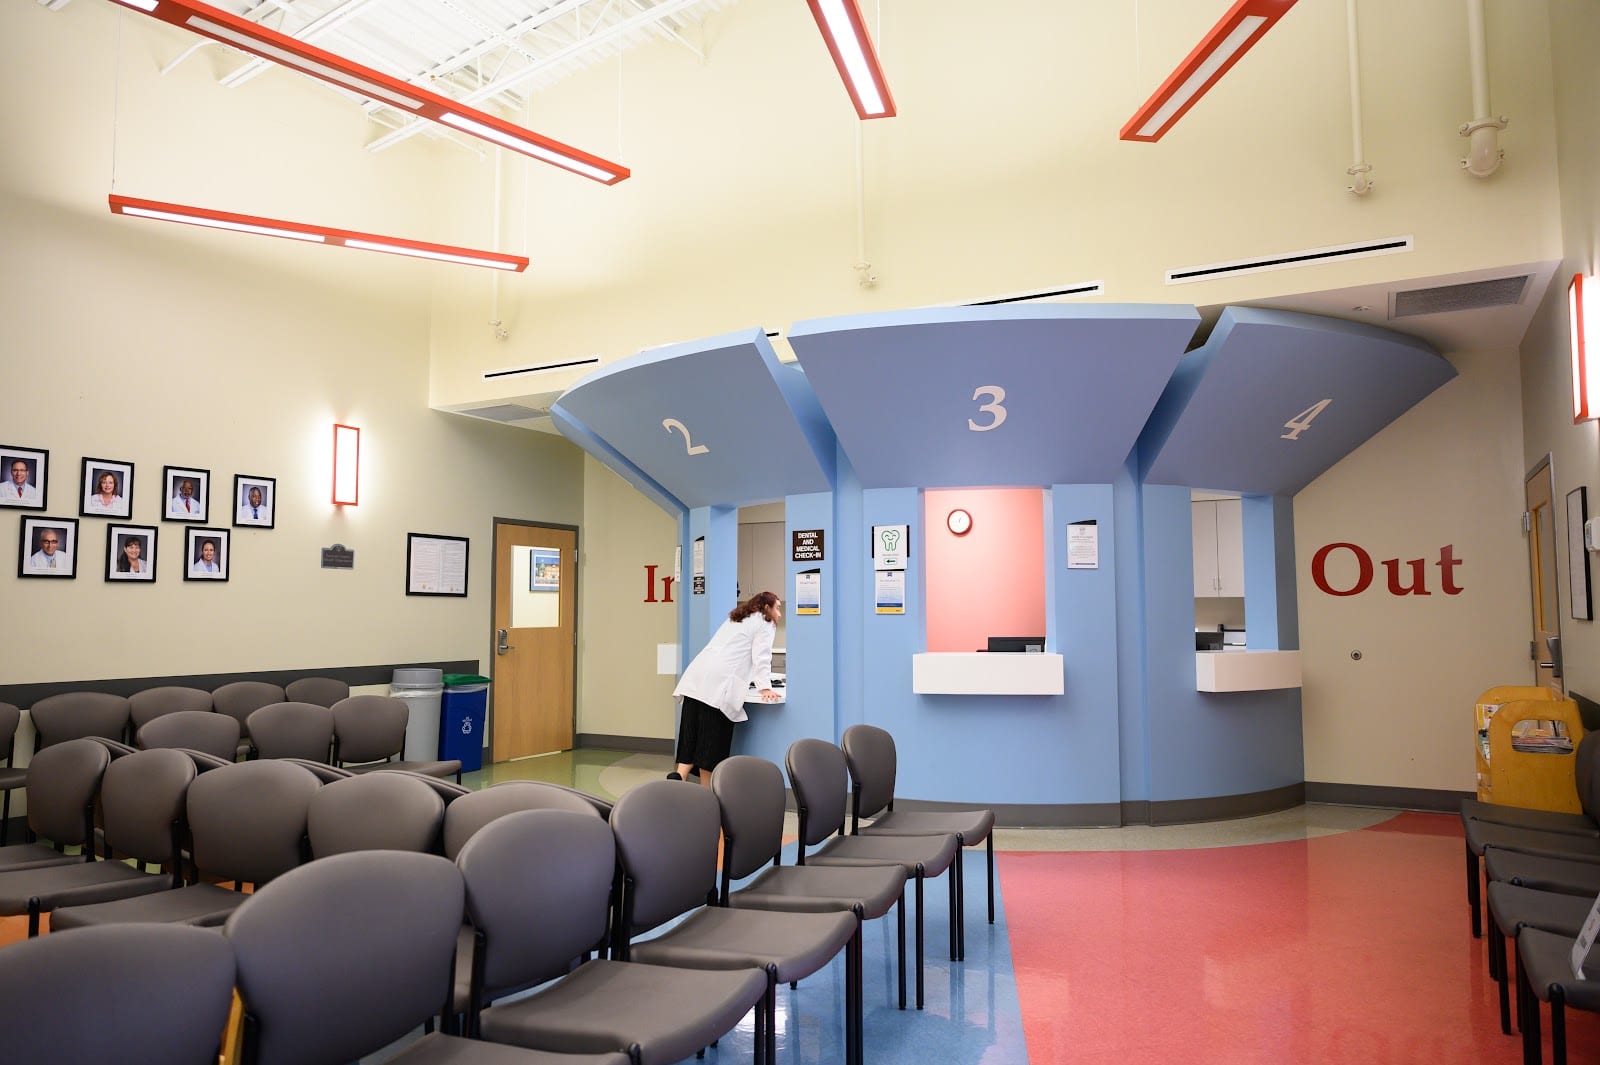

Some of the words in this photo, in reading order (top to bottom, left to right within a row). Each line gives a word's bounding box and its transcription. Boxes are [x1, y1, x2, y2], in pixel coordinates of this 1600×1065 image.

[968, 385, 1008, 432] 3
[1280, 398, 1333, 440] 4
[662, 418, 710, 456] 2
[1311, 542, 1464, 596] Out
